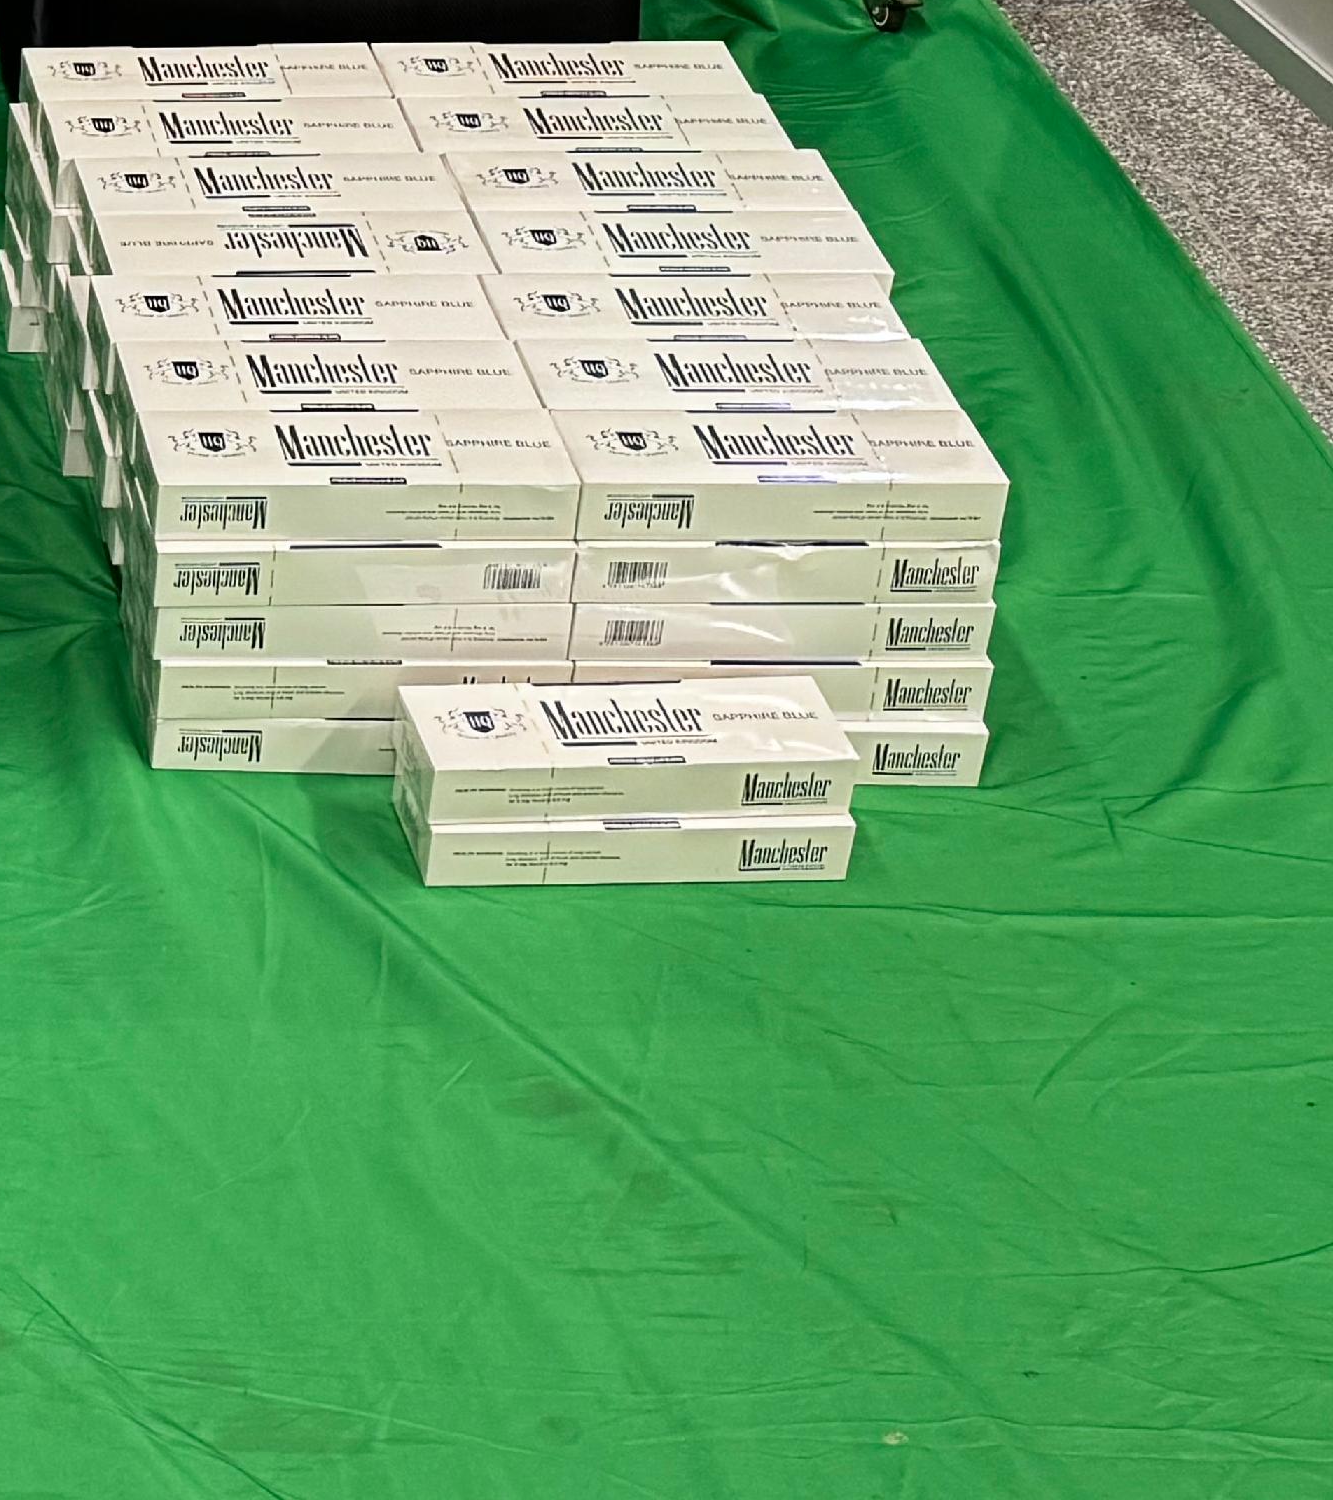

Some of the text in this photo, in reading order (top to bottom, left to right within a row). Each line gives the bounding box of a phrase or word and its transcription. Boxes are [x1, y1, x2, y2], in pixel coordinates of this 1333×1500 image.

[138, 55, 270, 82] Manchester
[488, 52, 626, 79] Manchester
[159, 111, 294, 140] Manchester
[524, 107, 663, 135] Manchester
[194, 166, 334, 195] Manchester
[572, 161, 716, 190] Manchester
[223, 228, 370, 258] Manchester
[601, 222, 751, 252] Manchester
[217, 287, 365, 320] Manchester
[615, 287, 768, 320] Manchester
[245, 353, 399, 389] Manchester
[654, 352, 812, 388] Manchester
[275, 422, 432, 461] Manchester
[693, 423, 855, 460] Manchester
[179, 500, 269, 530] Manchester
[604, 499, 695, 529] Manchester
[173, 565, 261, 596] Manchester
[890, 557, 980, 588] Manchester
[179, 620, 266, 650] Manchester
[885, 617, 974, 647] Manchester
[884, 678, 972, 708] Manchester
[539, 698, 702, 740] Manchester
[178, 731, 263, 762] Manchester
[872, 742, 961, 772] Manchester
[740, 771, 832, 803] Manchester
[738, 838, 829, 870] Manchester
